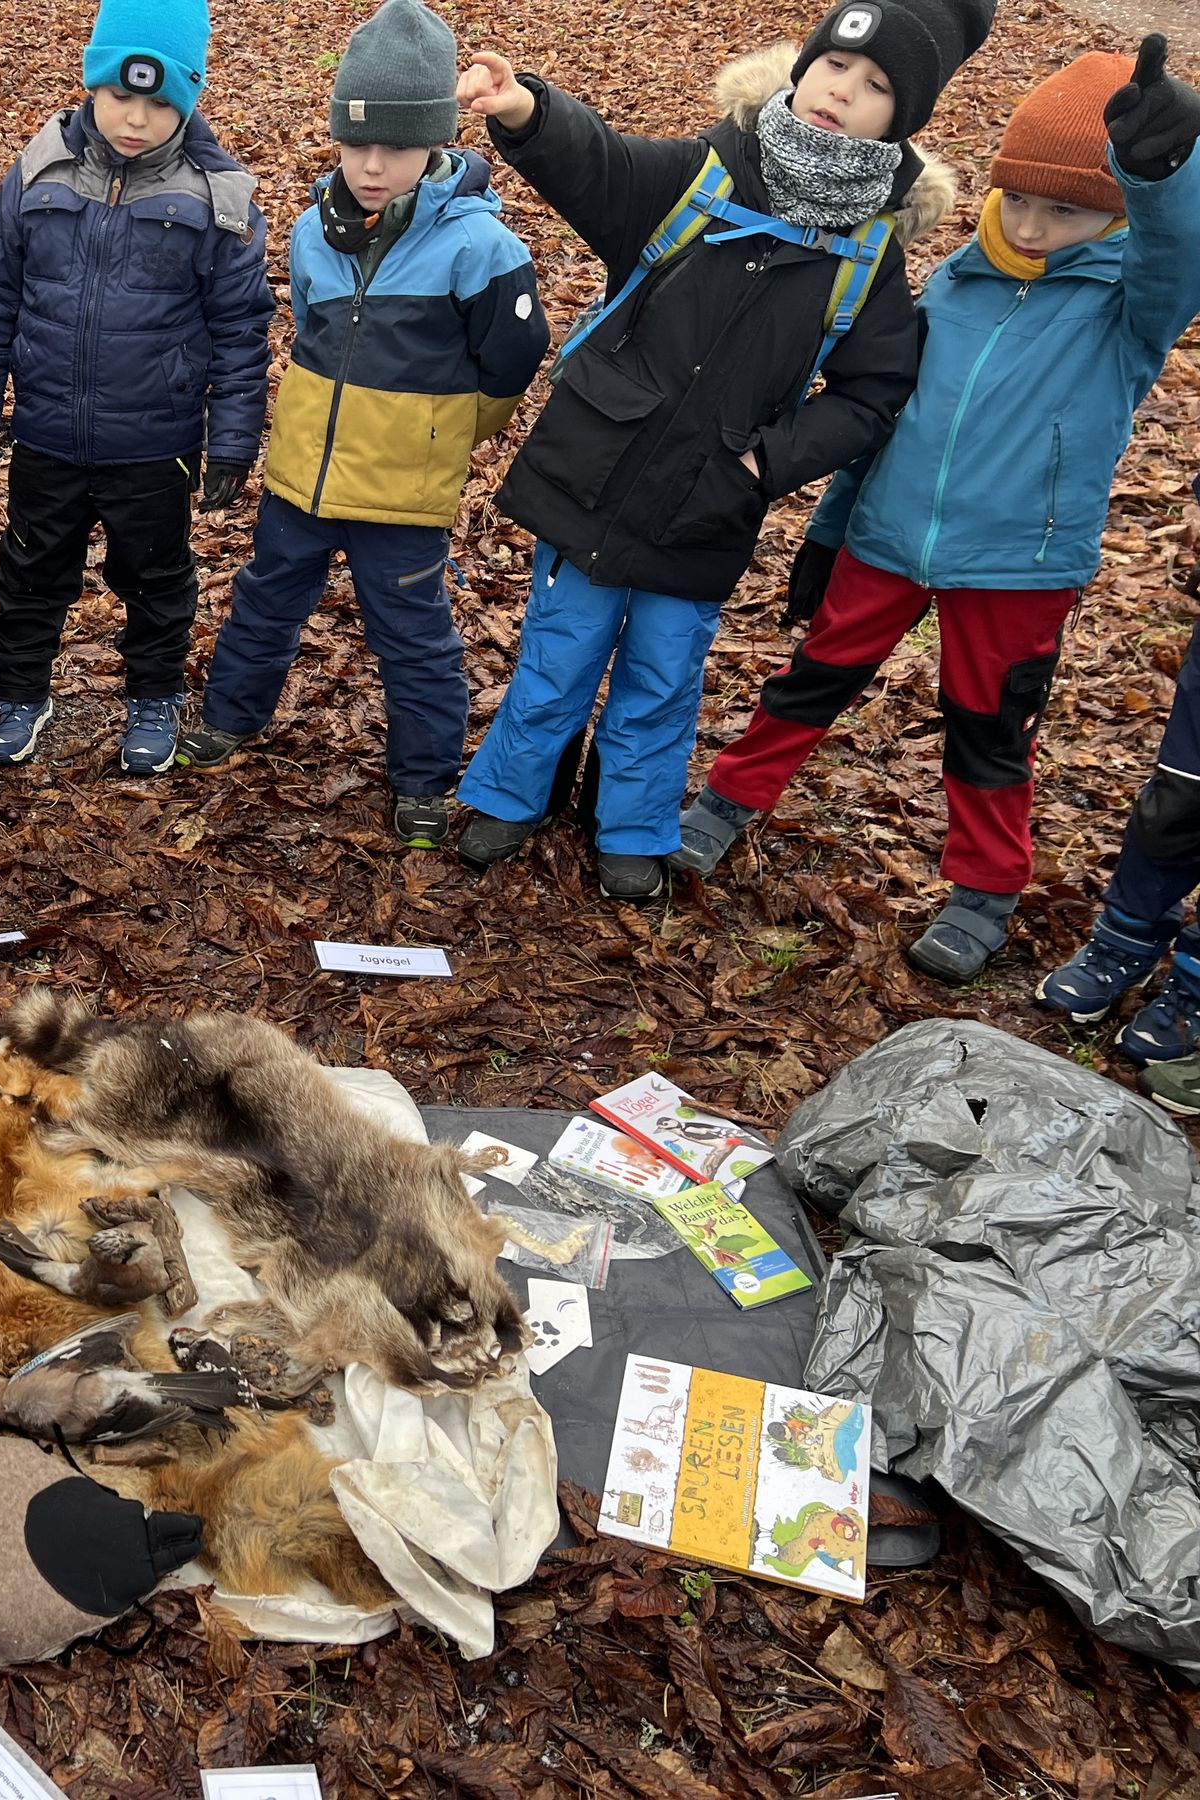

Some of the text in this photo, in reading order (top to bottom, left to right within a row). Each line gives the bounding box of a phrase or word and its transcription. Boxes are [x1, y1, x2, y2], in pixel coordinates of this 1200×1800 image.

[359, 954, 411, 966] Zugvögel
[617, 1091, 660, 1114] Vögel
[668, 1193, 719, 1213] Welcher
[678, 1201, 734, 1224] Baum ist
[718, 1404, 747, 1481] LESEN
[680, 1418, 715, 1520] SPUREN
